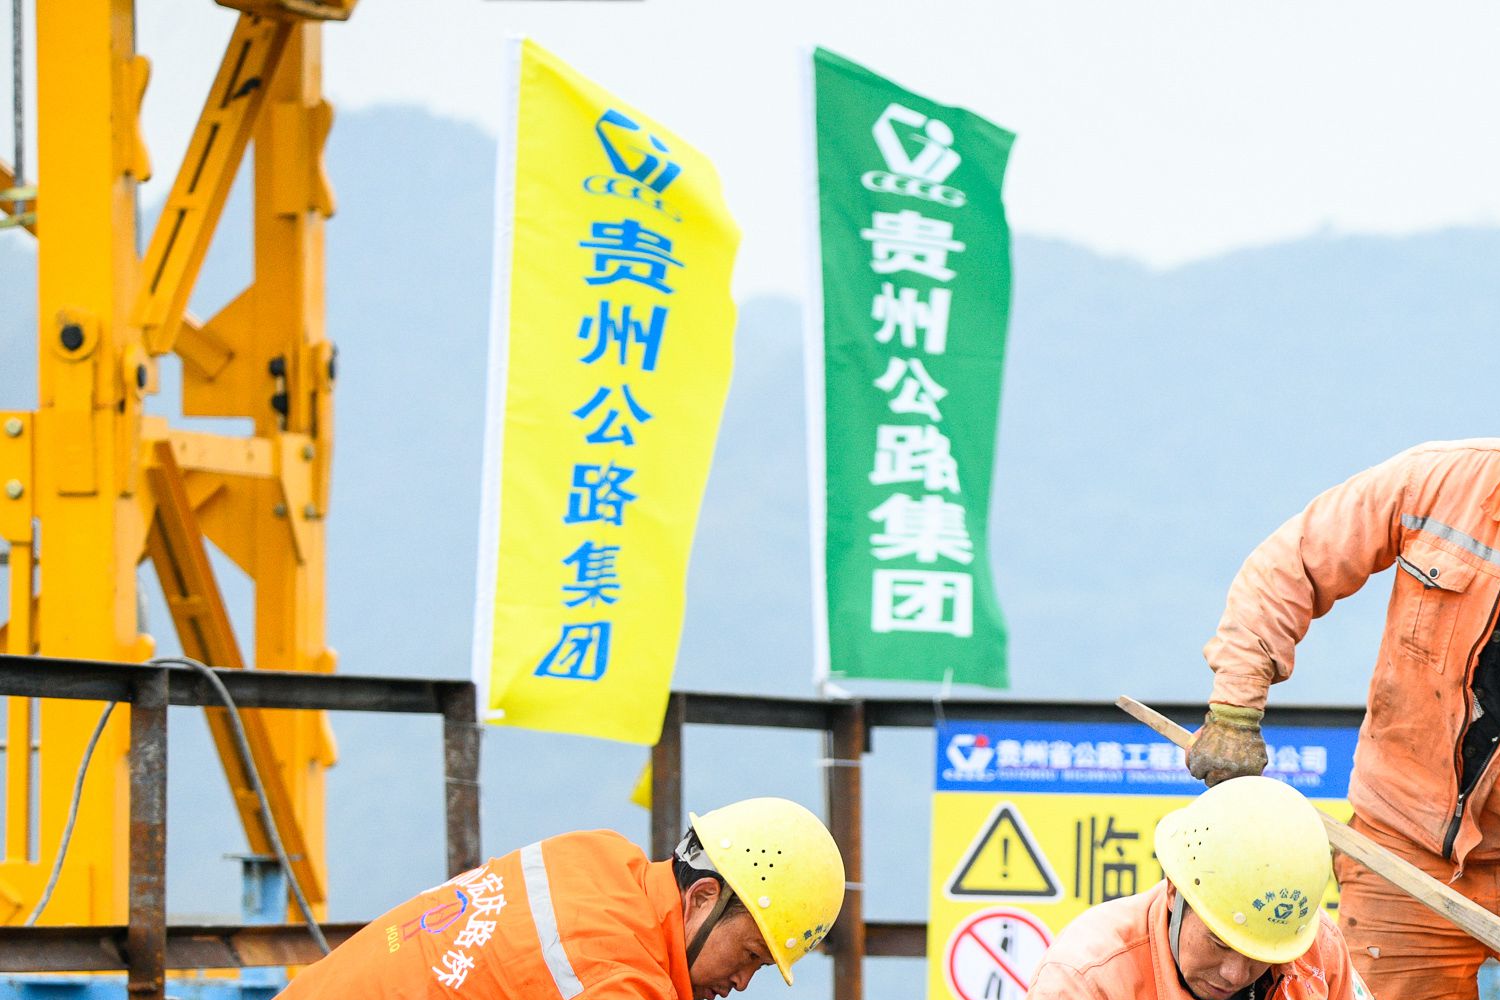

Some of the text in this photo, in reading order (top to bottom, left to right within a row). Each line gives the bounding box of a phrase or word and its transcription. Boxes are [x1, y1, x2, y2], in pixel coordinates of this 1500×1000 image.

[533, 218, 685, 681] 贵州公路集团
[861, 208, 975, 637] 贵州公路集团
[1075, 815, 1165, 905] 临
